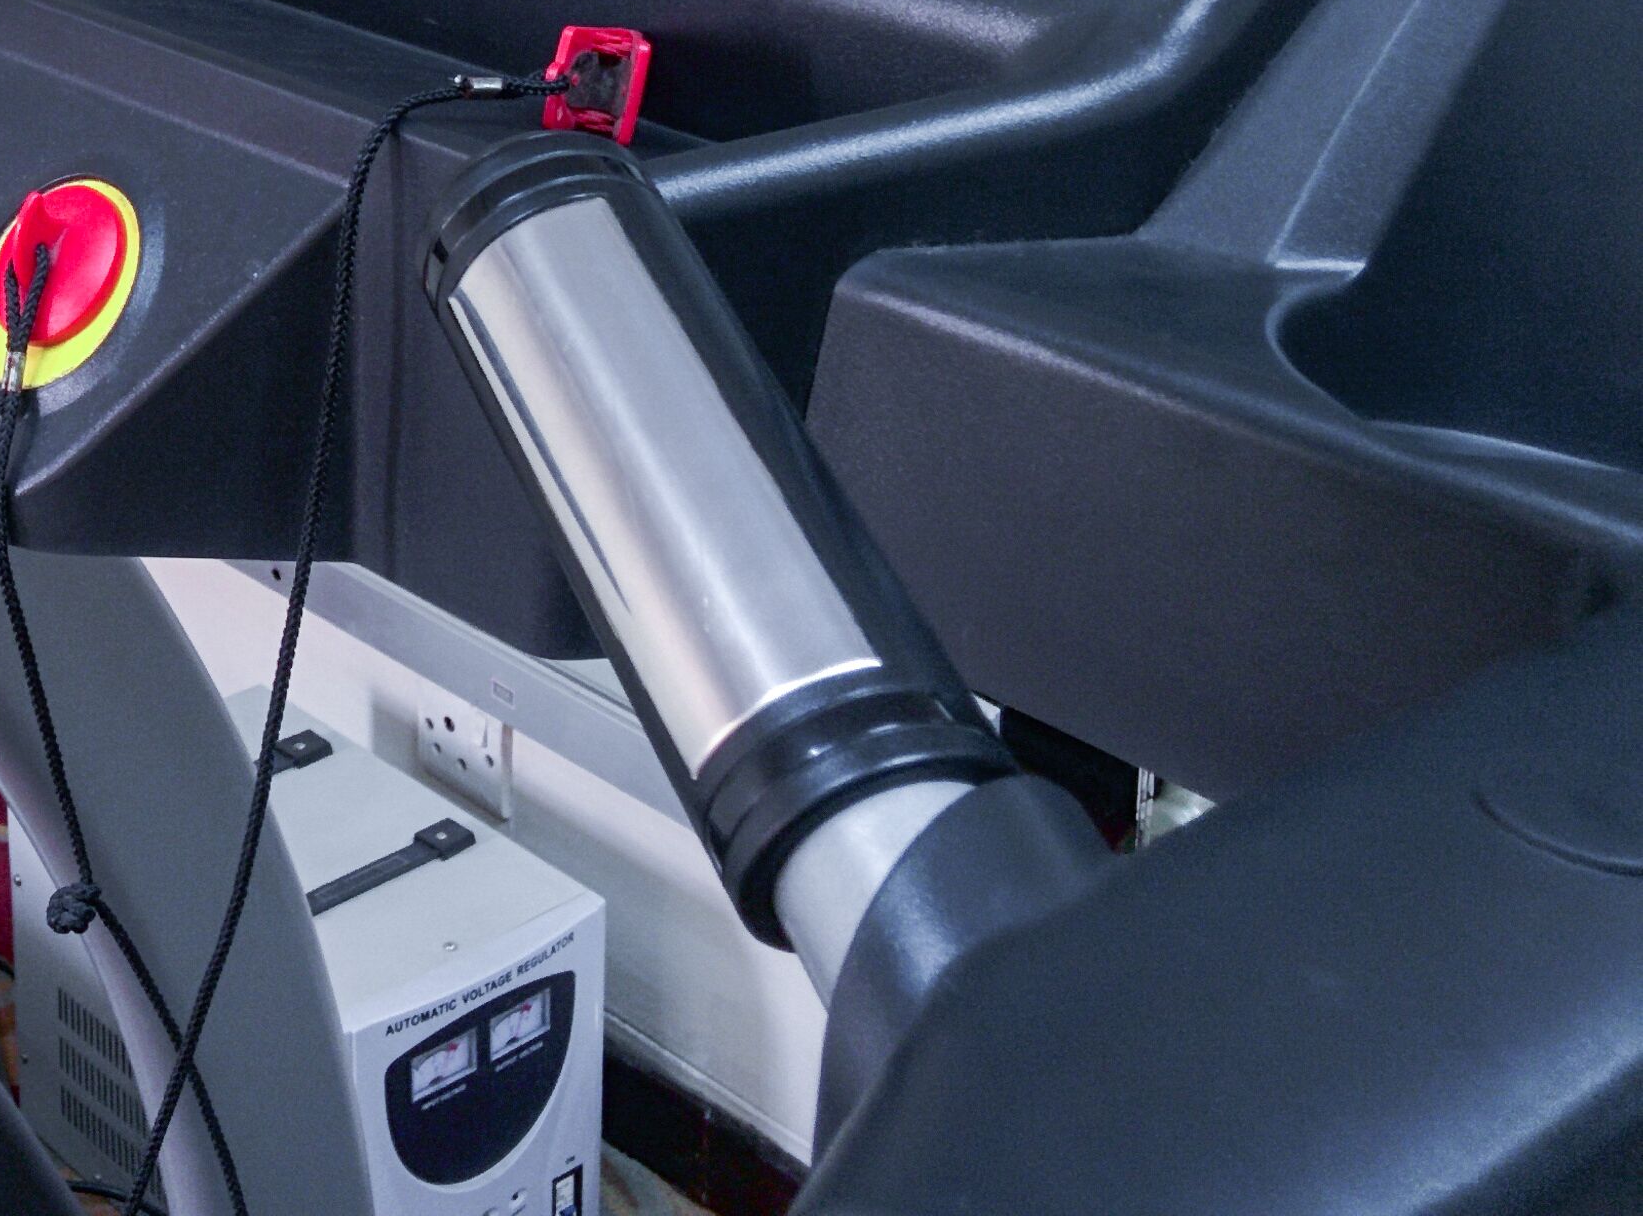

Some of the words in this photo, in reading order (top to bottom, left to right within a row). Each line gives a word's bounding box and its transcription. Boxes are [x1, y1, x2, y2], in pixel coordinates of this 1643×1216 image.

[385, 999, 457, 1036] AUTOMATIC
[461, 971, 513, 1003] VOLTAGE
[516, 932, 575, 977] REGULATOR
